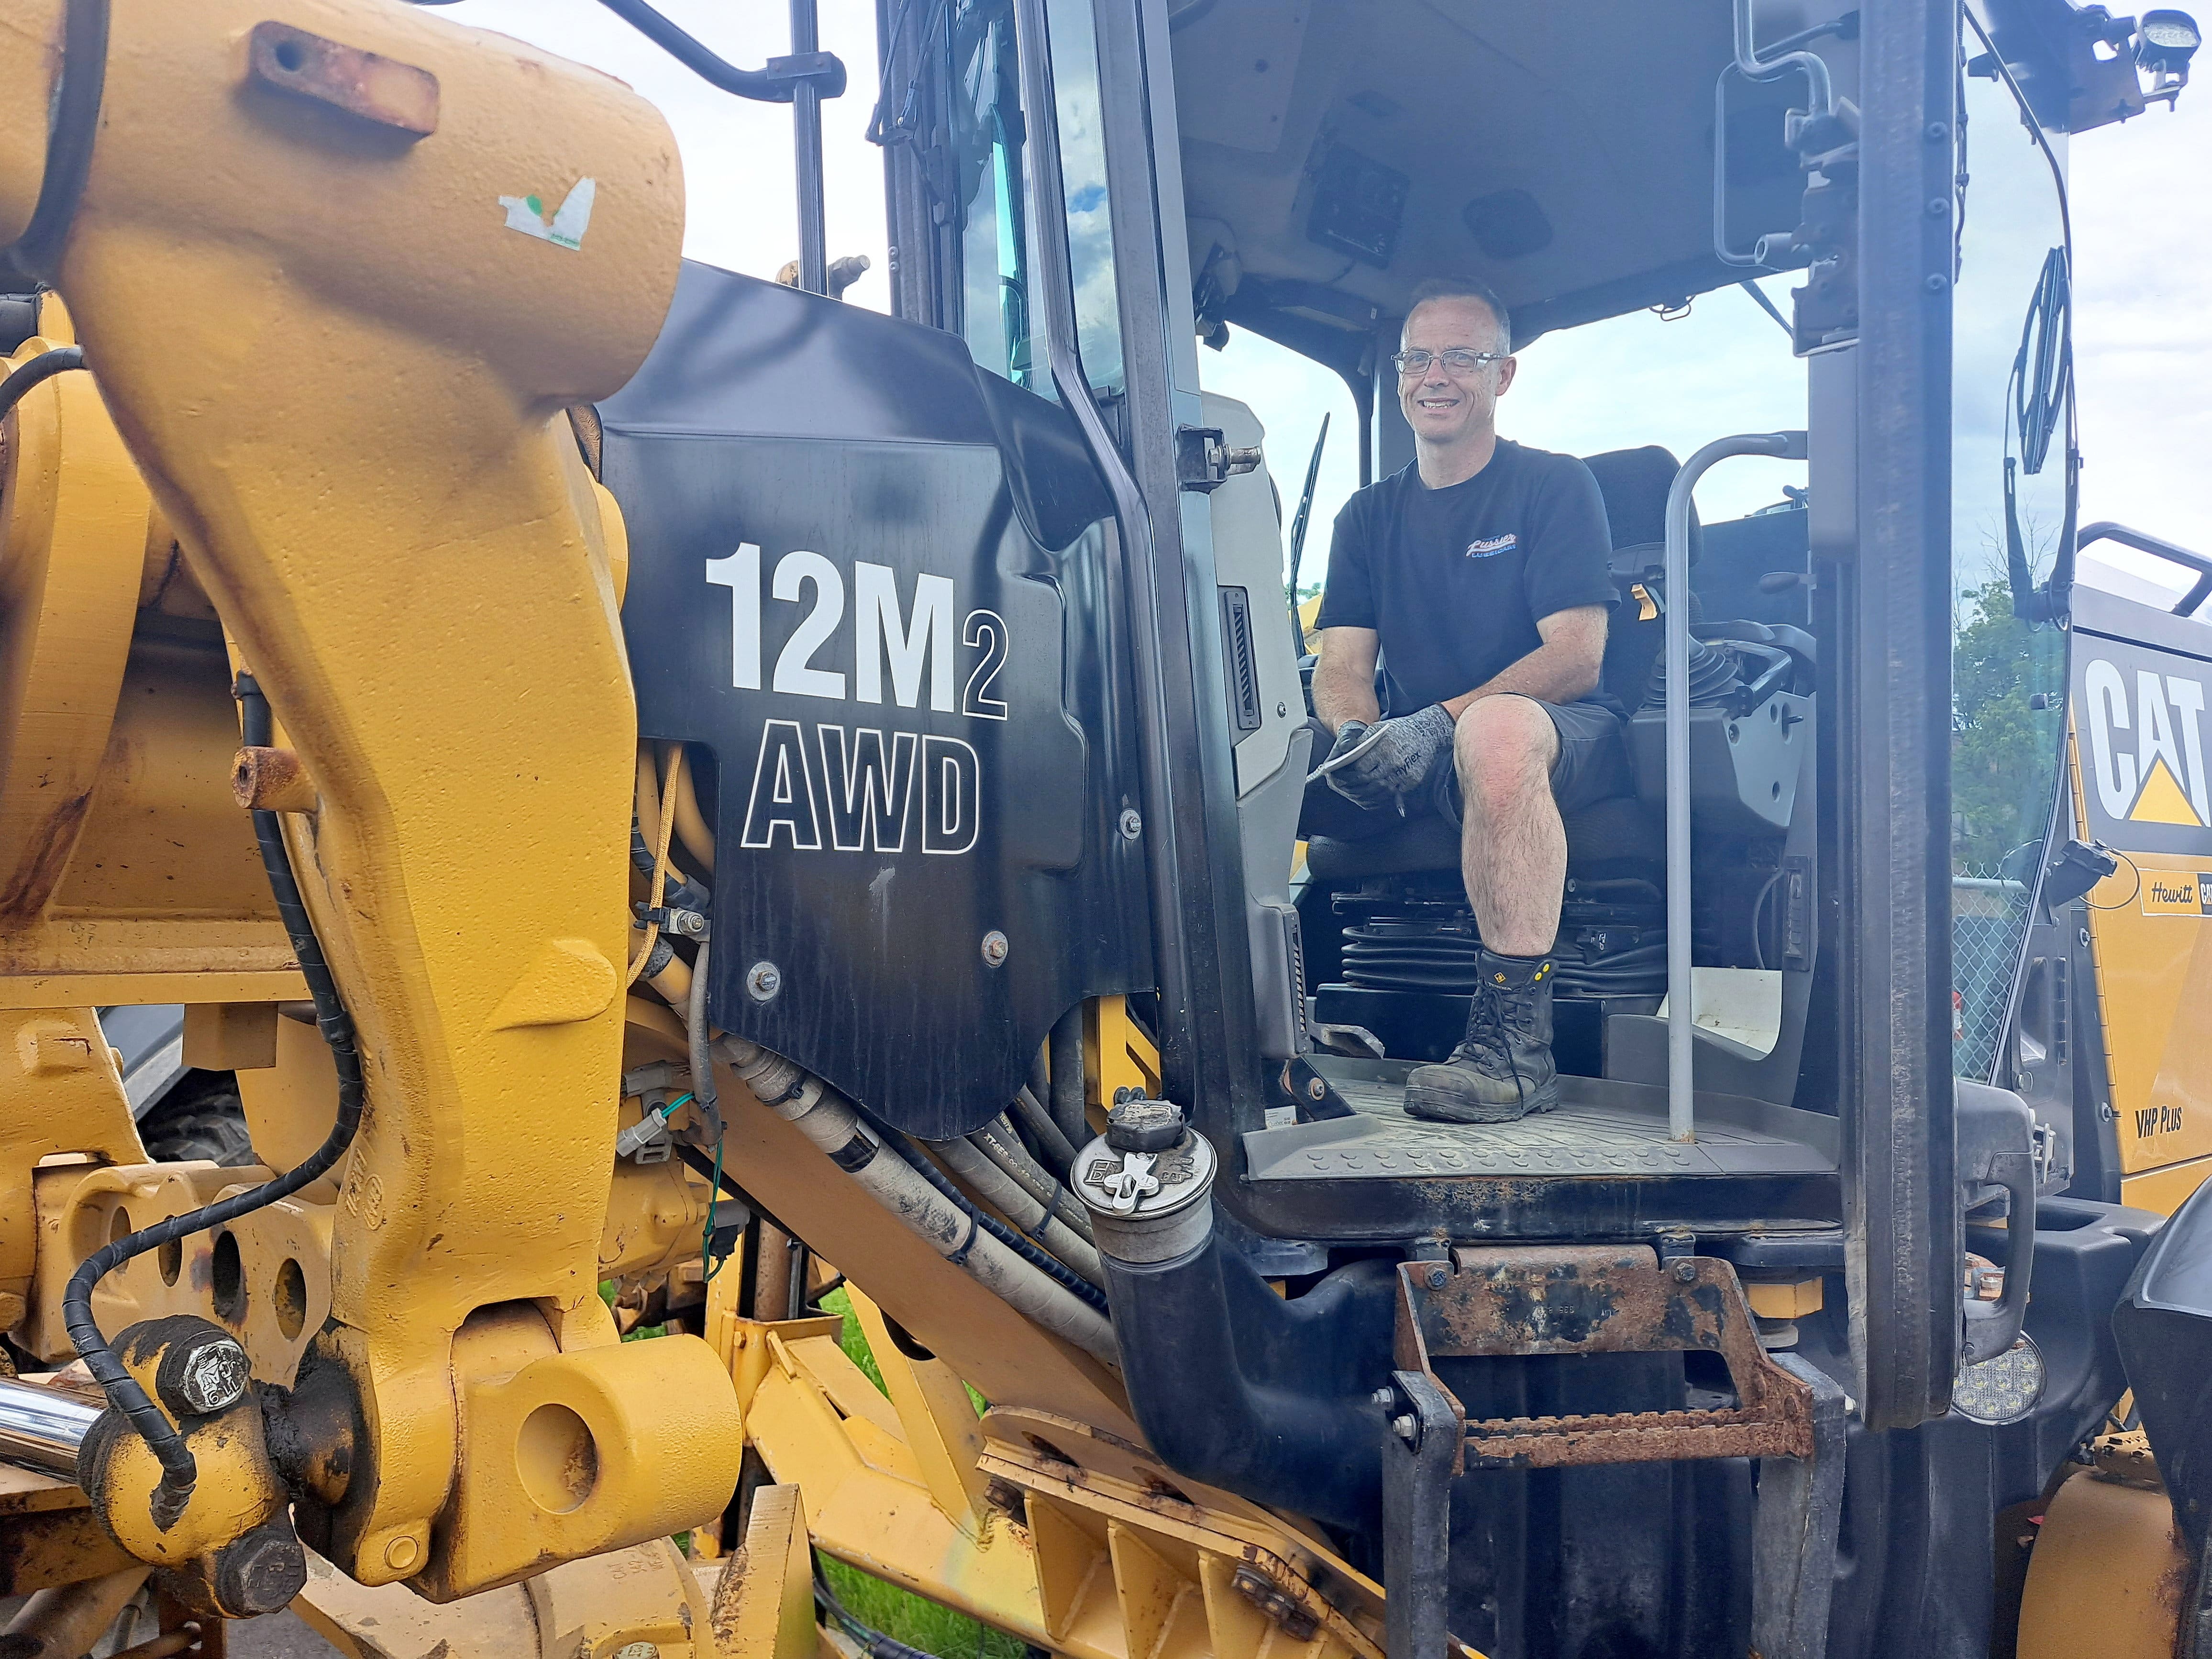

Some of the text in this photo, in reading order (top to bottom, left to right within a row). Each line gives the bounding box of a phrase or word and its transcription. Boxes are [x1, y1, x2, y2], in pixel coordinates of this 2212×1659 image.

[2085, 659, 2211, 828] CAT
[741, 718, 979, 854] AWD
[2151, 881, 2193, 903] Hewitt
[2135, 1107, 2158, 1139] VHP
